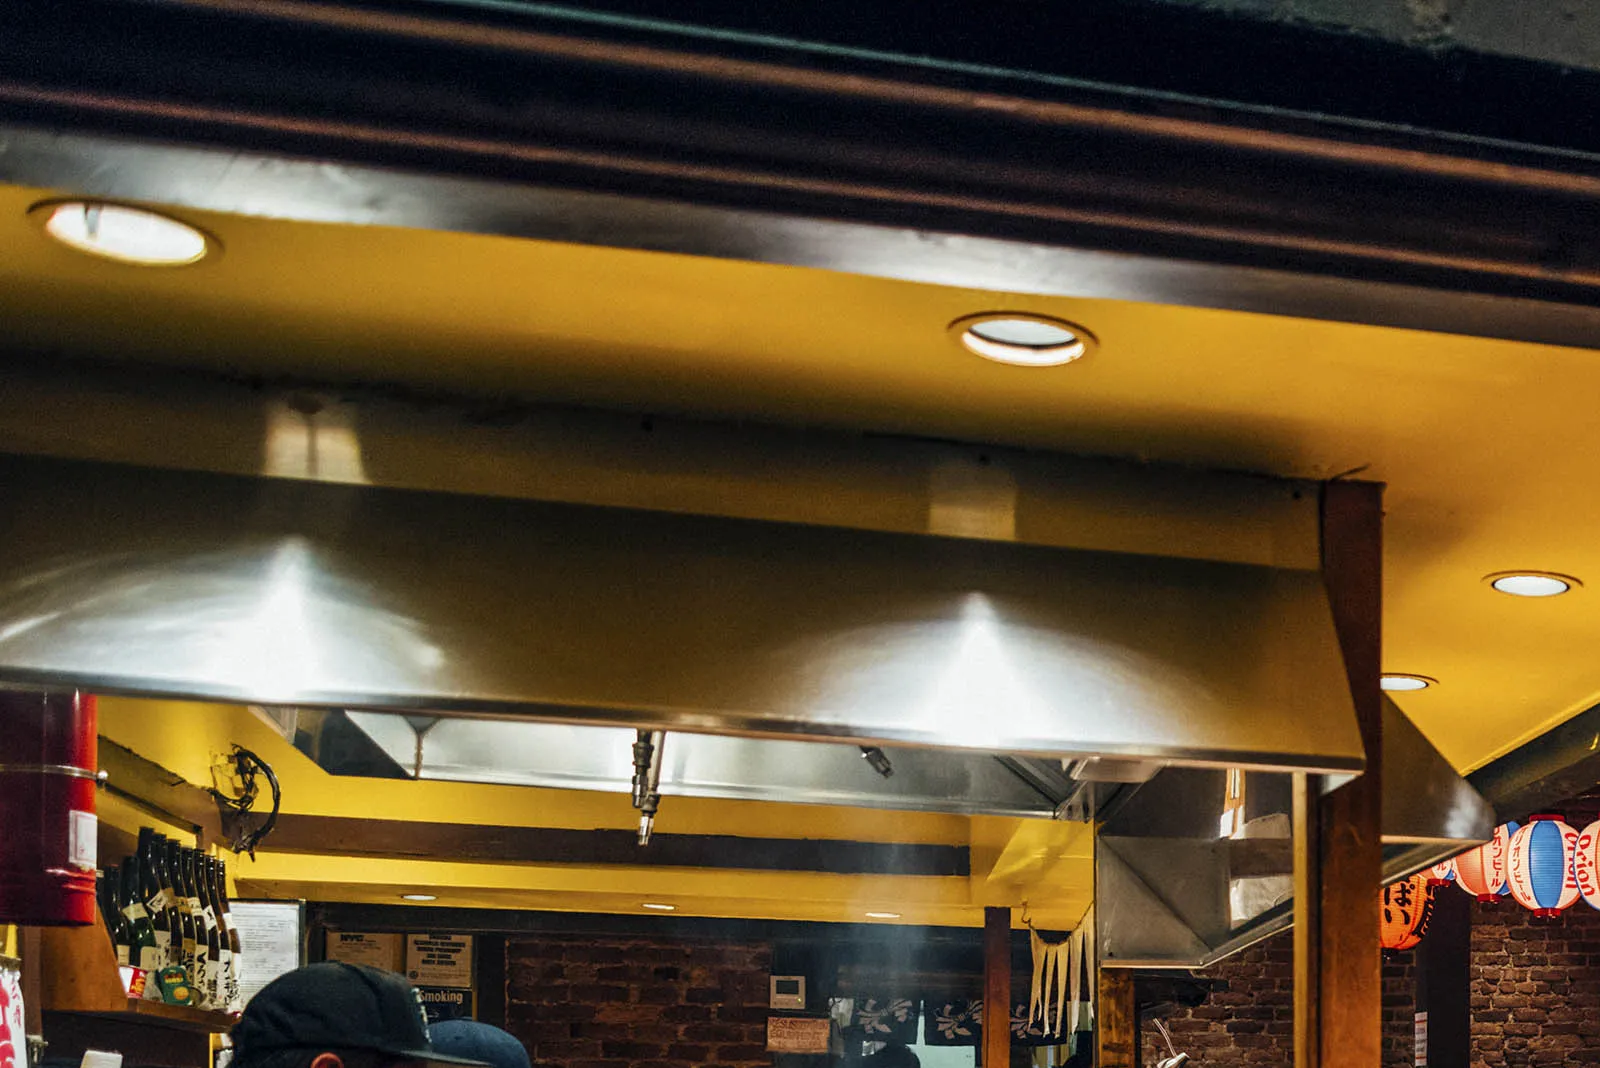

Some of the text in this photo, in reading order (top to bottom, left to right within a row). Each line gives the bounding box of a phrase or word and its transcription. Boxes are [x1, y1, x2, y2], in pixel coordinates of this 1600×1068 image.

[1491, 827, 1502, 887] リオンビール
[1513, 826, 1531, 901] オリオンビール
[1575, 833, 1596, 897] Orion
[419, 989, 463, 1005] Smoking
